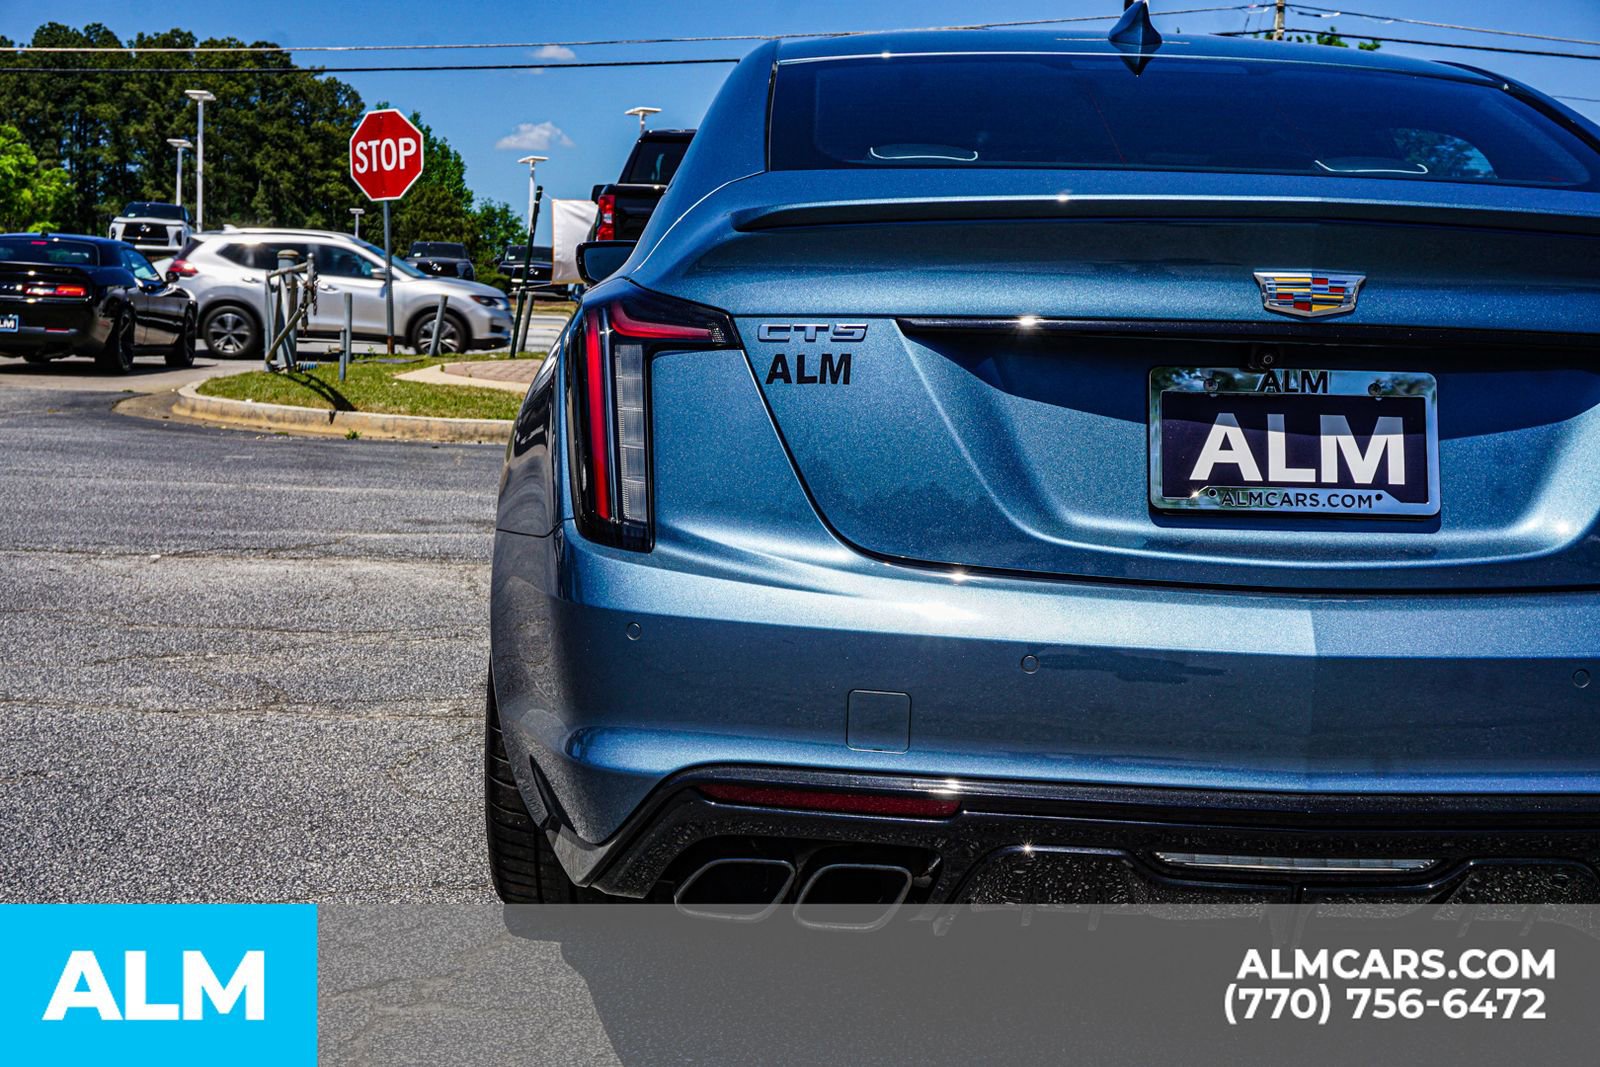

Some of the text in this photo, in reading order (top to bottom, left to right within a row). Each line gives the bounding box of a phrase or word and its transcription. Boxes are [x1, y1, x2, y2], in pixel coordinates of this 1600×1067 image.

[355, 137, 417, 174] STOP
[765, 353, 852, 385] ALM
[1257, 371, 1328, 394] ALM
[1189, 412, 1406, 485] ALM
[1221, 491, 1373, 508] ALMCARS.COM
